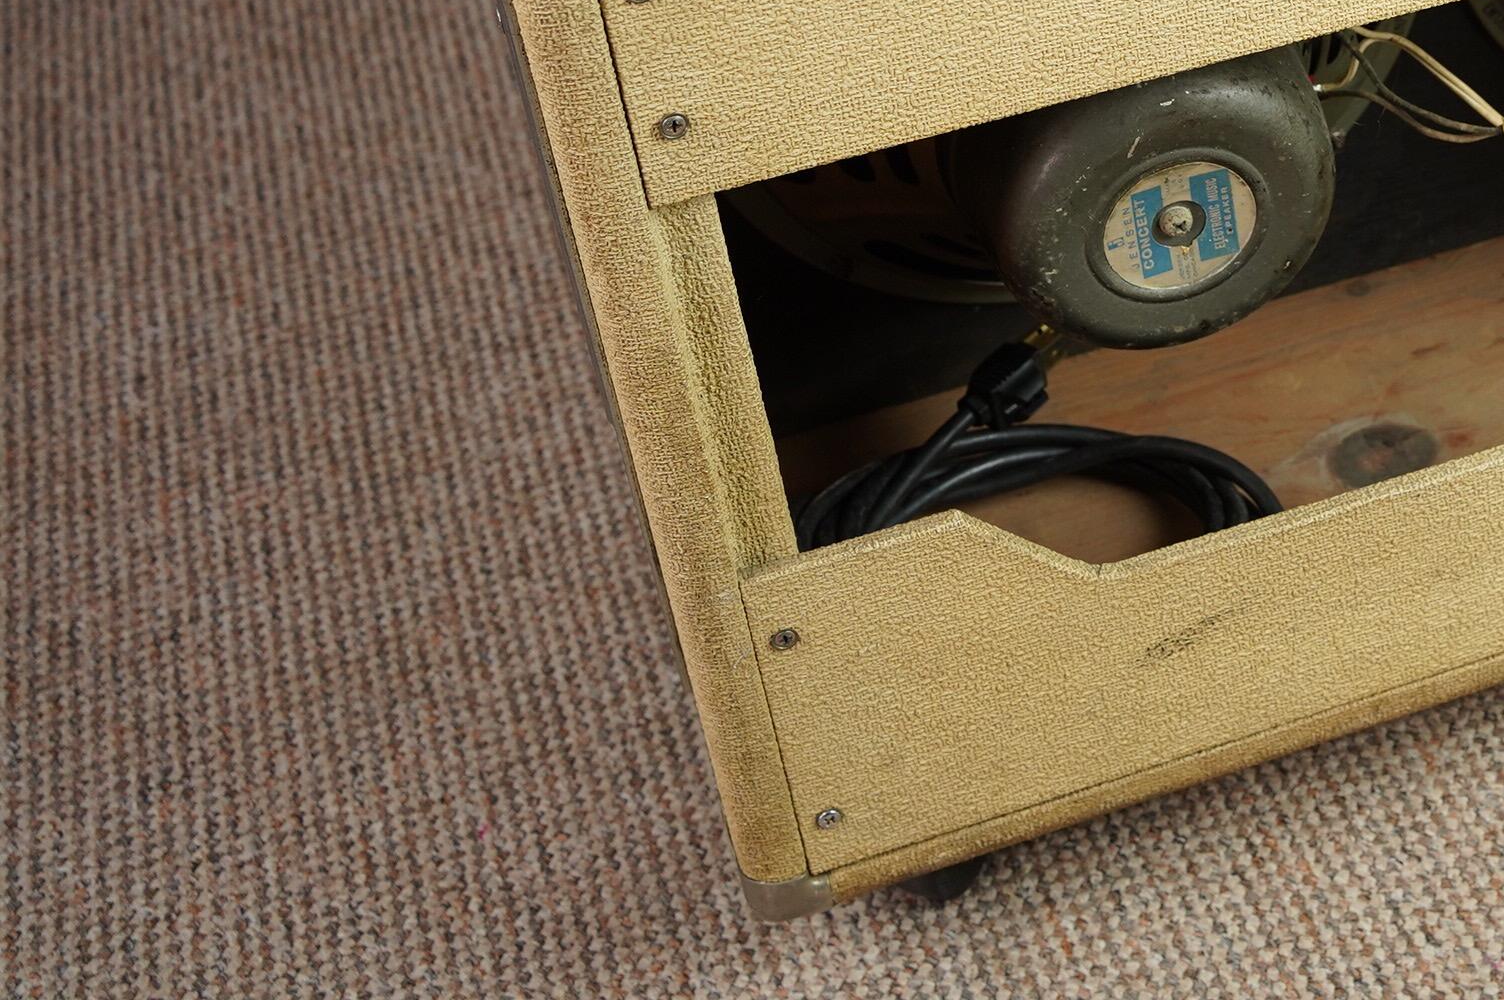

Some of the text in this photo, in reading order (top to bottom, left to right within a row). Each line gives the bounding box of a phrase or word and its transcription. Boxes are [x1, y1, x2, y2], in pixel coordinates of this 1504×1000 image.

[1122, 207, 1141, 271] JENSEN
[1133, 199, 1155, 271] CONCERT
[1204, 177, 1227, 250] ELECTRONIC MUSIC
